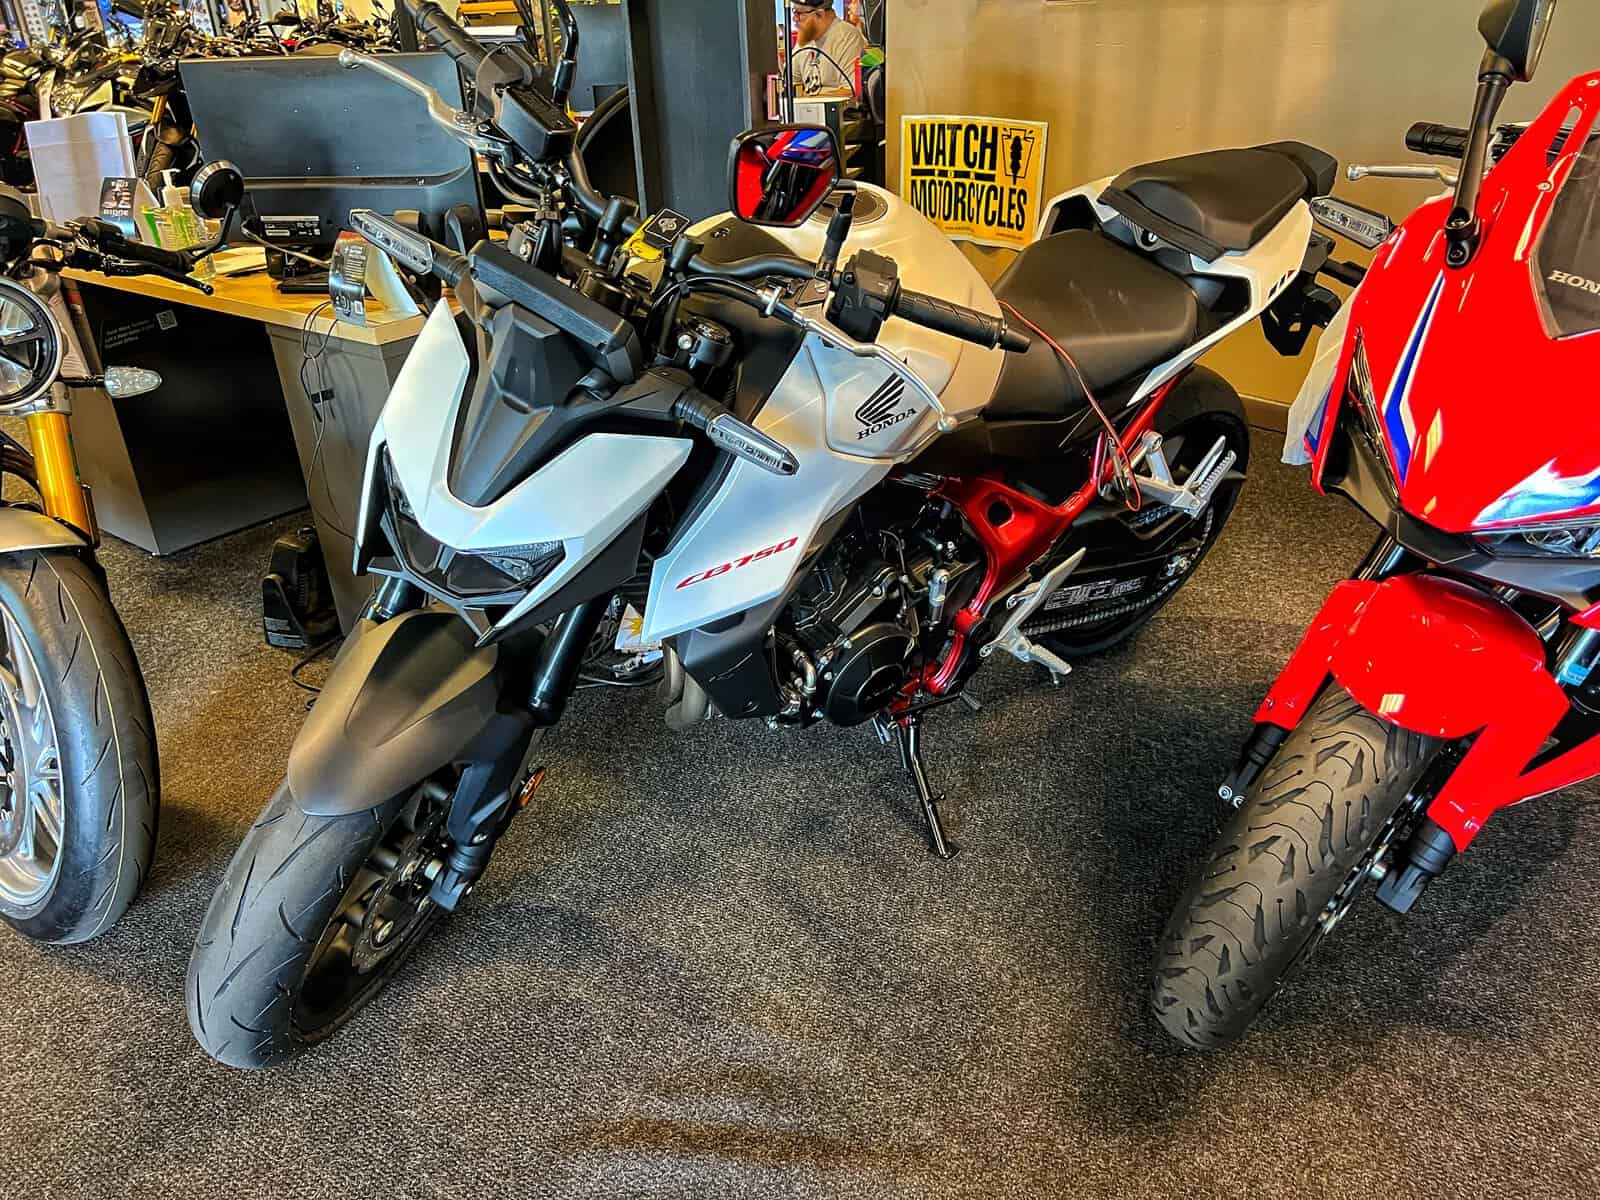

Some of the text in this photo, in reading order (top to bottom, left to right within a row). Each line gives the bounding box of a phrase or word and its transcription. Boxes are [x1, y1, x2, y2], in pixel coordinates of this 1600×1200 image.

[911, 123, 998, 170] WATCH
[911, 178, 1027, 231] MOTORCYCLES
[1547, 269, 1600, 297] HON
[856, 407, 917, 440] HONDA
[676, 536, 799, 590] CB750
